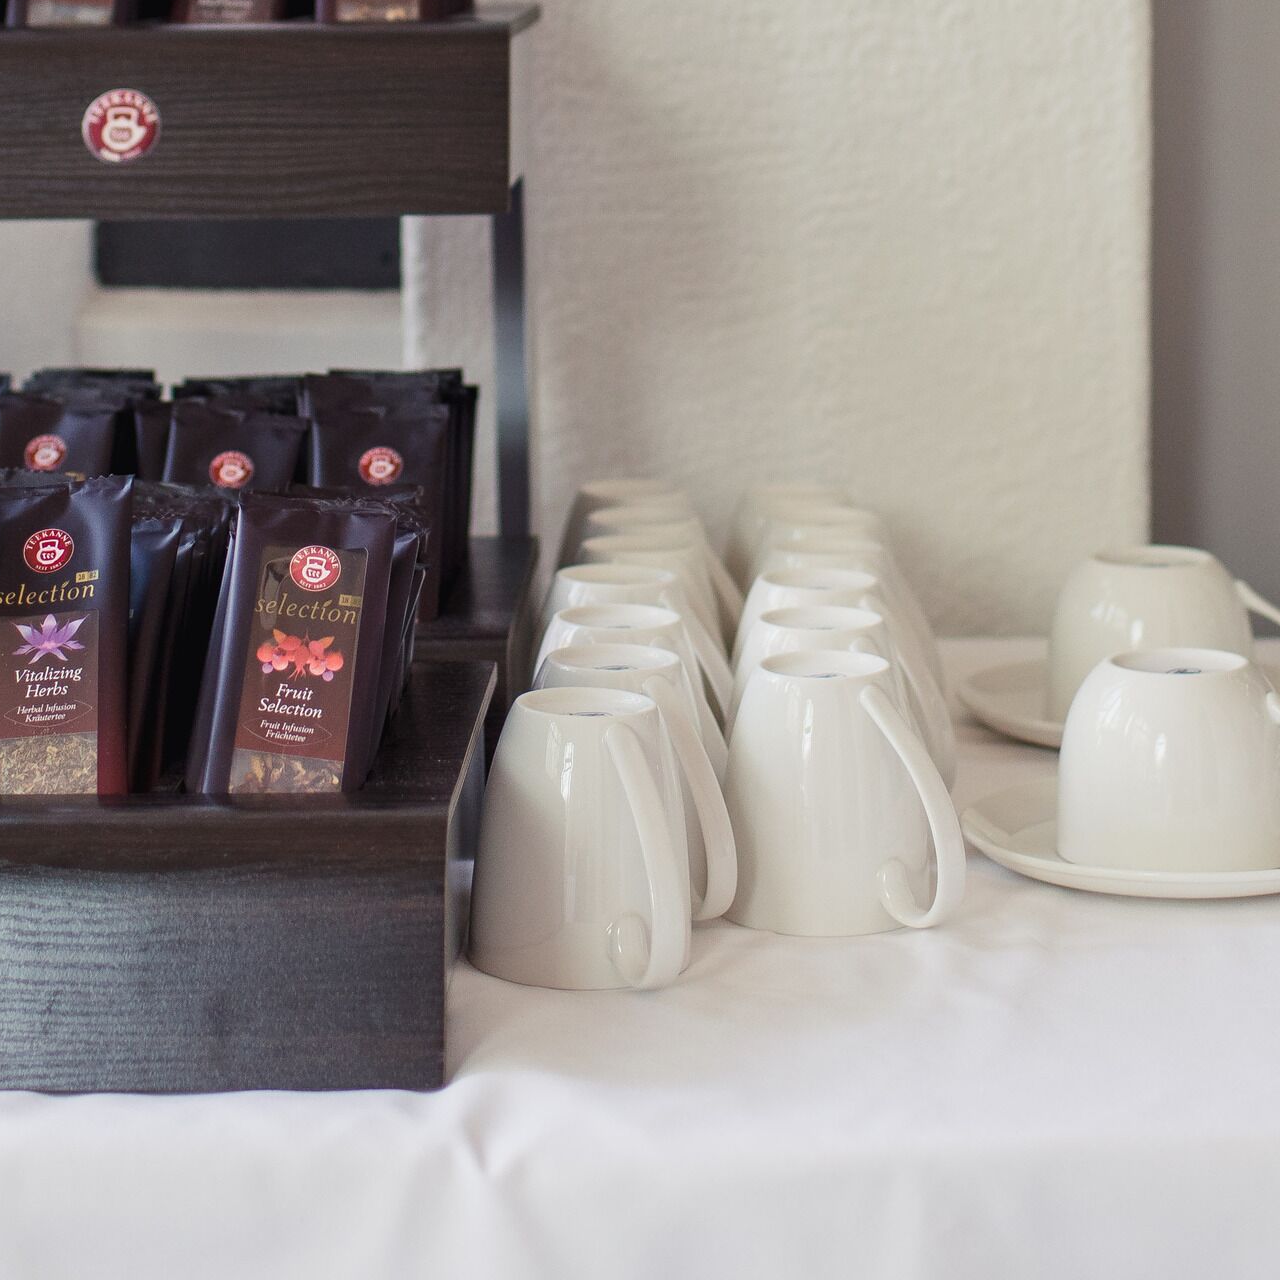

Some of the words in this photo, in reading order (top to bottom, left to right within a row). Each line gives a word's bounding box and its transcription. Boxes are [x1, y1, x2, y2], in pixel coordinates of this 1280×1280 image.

[26, 530, 72, 549] TEEKANNE
[293, 547, 339, 569] TEEKANNE
[255, 593, 356, 625] selection
[15, 666, 83, 683] Vitalizing
[25, 681, 69, 698] Herbs
[276, 683, 314, 701] Fruit
[17, 704, 44, 715] Herbal
[45, 703, 77, 713] Infusion
[258, 698, 323, 719] Selection
[260, 720, 281, 730] Fruit
[282, 722, 315, 734] Infusion
